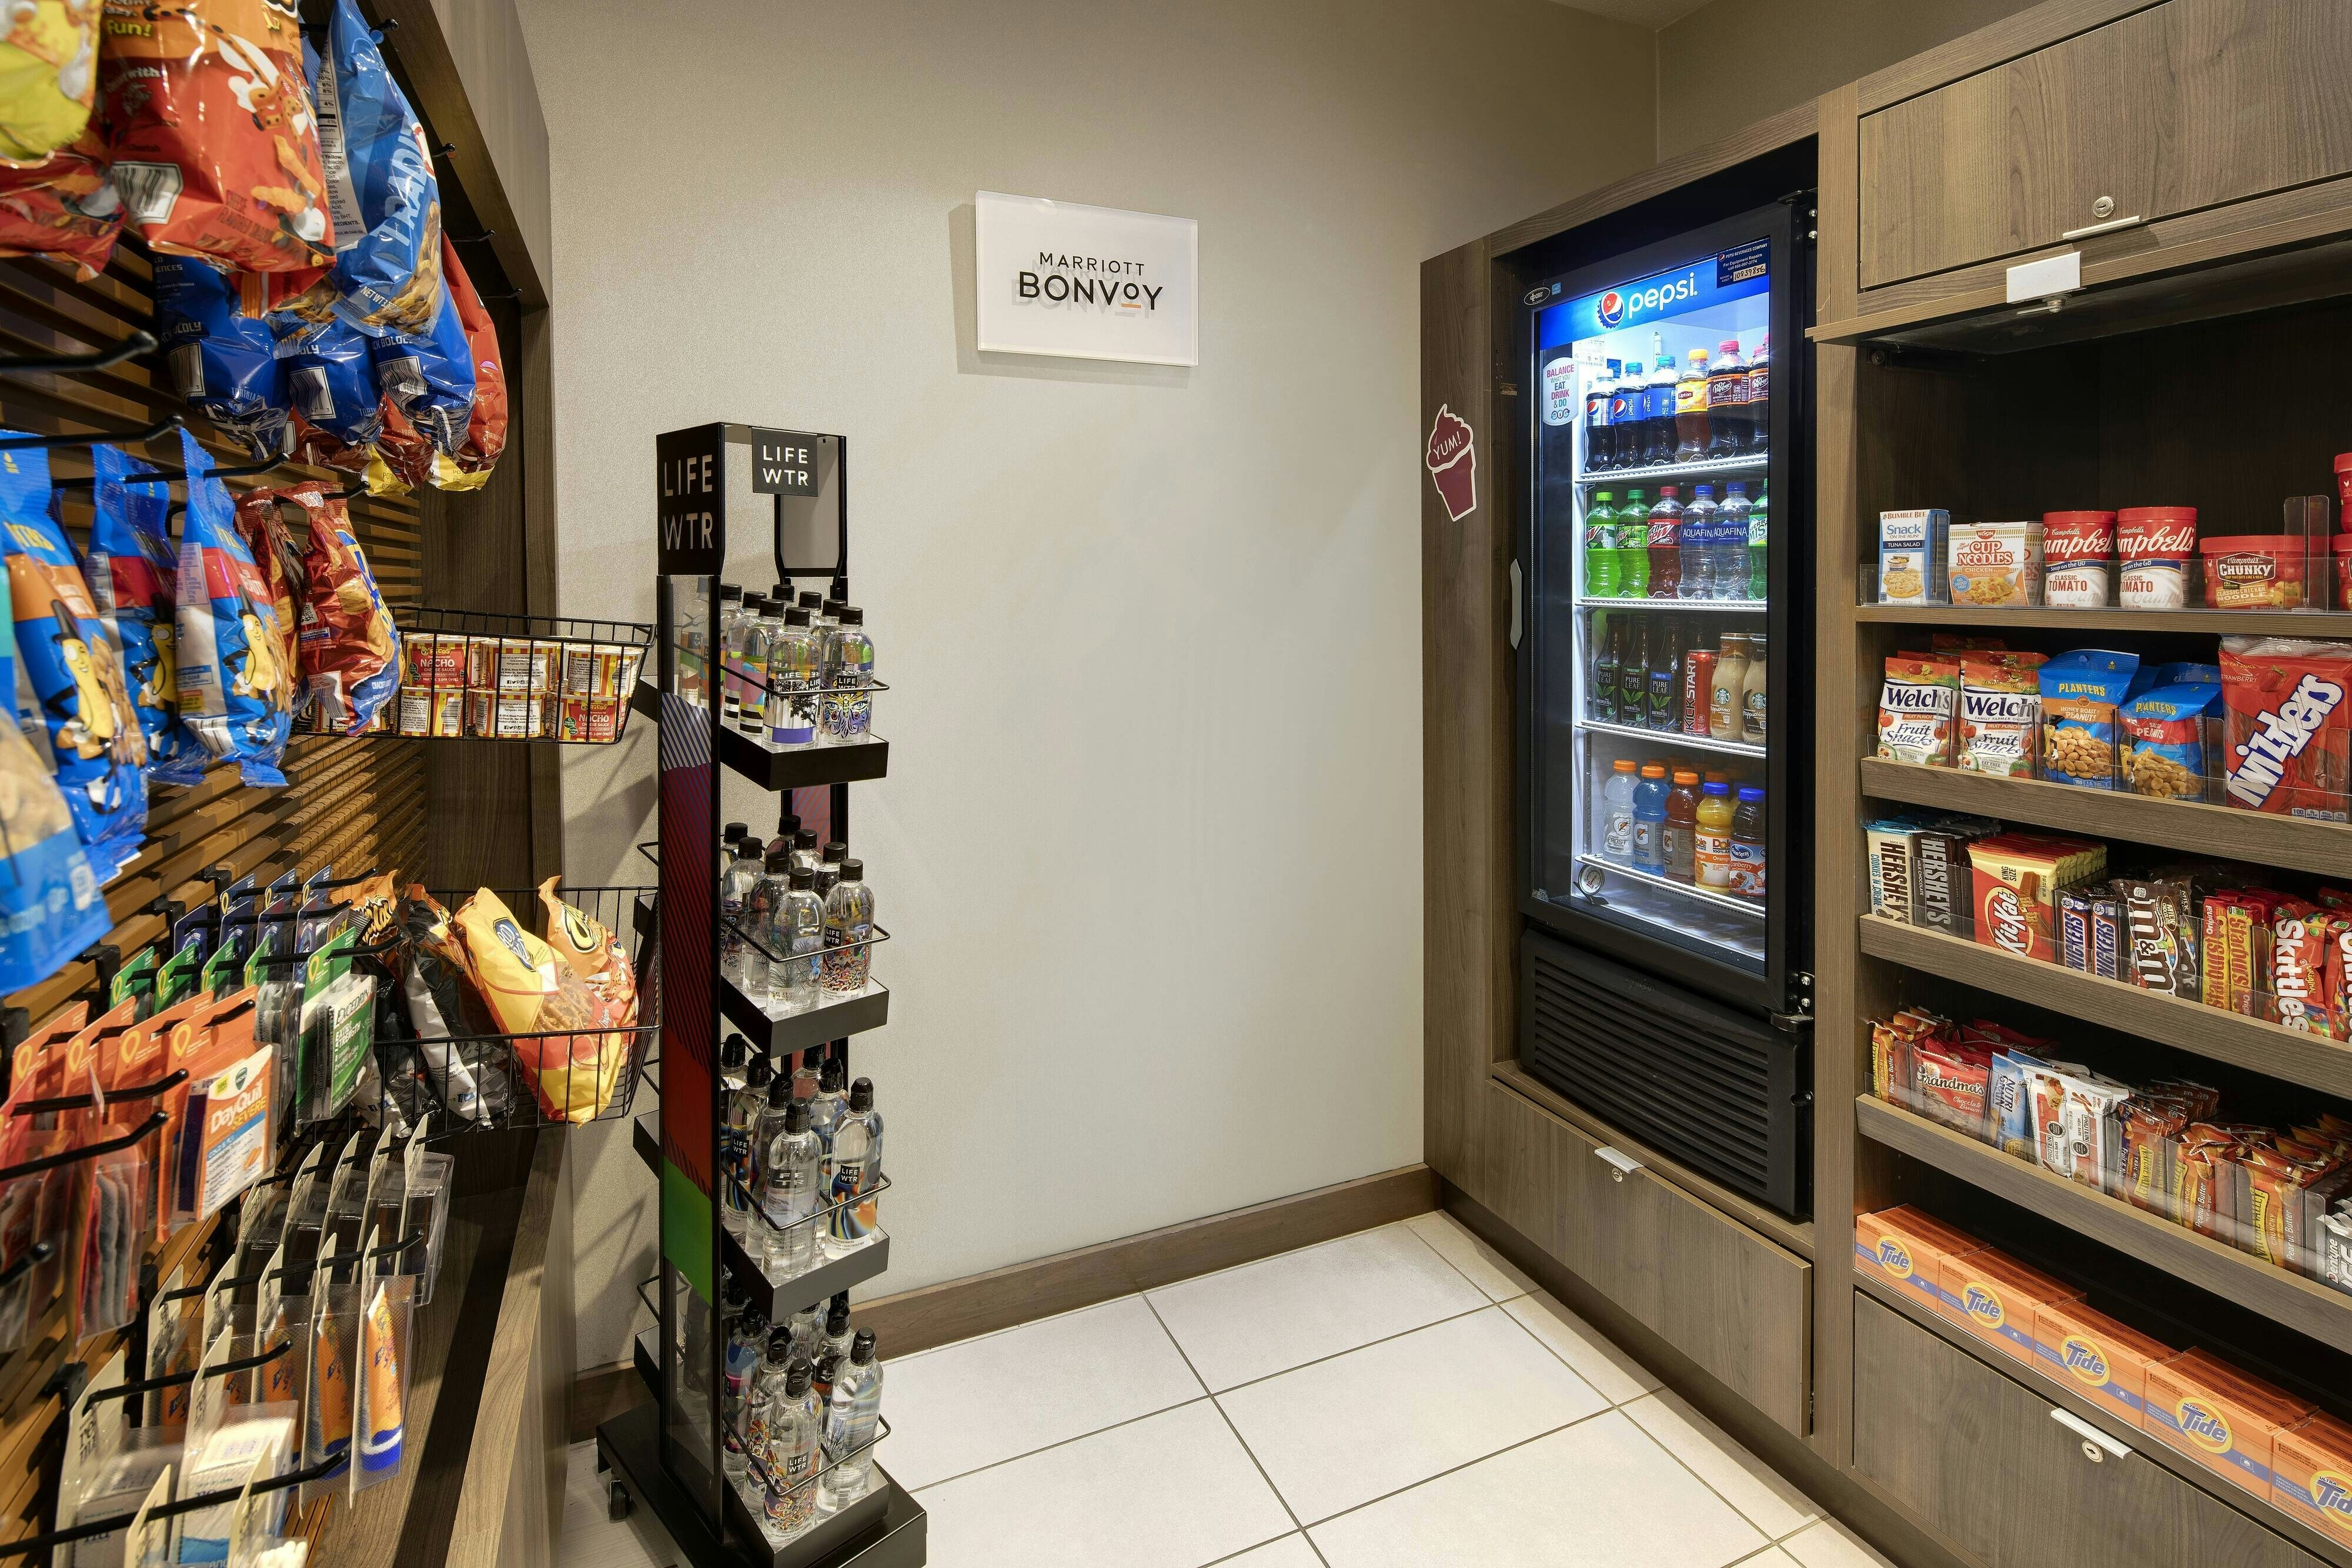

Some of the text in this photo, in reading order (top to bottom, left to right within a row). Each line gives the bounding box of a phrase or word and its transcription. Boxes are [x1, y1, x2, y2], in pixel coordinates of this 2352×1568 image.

[1735, 248, 1752, 256] BEVERAGES
[1752, 243, 1768, 251] COMPANY
[1040, 252, 1144, 276] MARRIOTT
[1019, 271, 1163, 310] BONVOY
[1628, 272, 1698, 319] pepsi
[1546, 364, 1575, 379] BALANCE
[1554, 382, 1566, 391] EAT
[1713, 382, 1732, 393] Pepper
[1551, 389, 1570, 400] DRINK
[1558, 399, 1567, 407] DO
[1433, 431, 1462, 460] YUM!
[763, 444, 808, 464] LIFE
[664, 454, 713, 497] LIFE
[762, 467, 809, 486] WTR
[662, 511, 713, 551] WTR
[1714, 527, 1749, 537] AQUAFINA
[1887, 524, 1922, 534] Snack
[1970, 541, 2002, 553] CUP
[1957, 551, 2013, 566] NOODLES
[2219, 564, 2274, 576] CHUNKY
[2049, 580, 2087, 591] TOMATO
[2217, 589, 2240, 597] CLASSIC
[2217, 592, 2268, 602] NOODLE
[2221, 674, 2257, 683] STRAWBERRY
[1684, 657, 1696, 731] KICKSTART
[2059, 683, 2106, 697] PLANTERS
[1886, 687, 1950, 710] Welch's
[1966, 696, 2039, 717] Welch's
[2065, 711, 2097, 722] PEANUTS
[1896, 723, 1931, 735] Fruit
[1885, 730, 1935, 745] Snacks
[1983, 733, 2019, 746] Fruit
[1730, 861, 1752, 870] Cranberry
[1870, 854, 1882, 907] COOKIES CREME
[2001, 866, 2009, 881] KING
[2009, 868, 2017, 882] SIZE
[1920, 839, 1952, 924] HERSHEY'S
[826, 928, 840, 937] LIFE
[2276, 918, 2310, 1032] Skittles
[1916, 1065, 1985, 1096] Grandma's
[1953, 1096, 1982, 1108] Chocolate
[2006, 1078, 2016, 1113] NUTRI
[211, 1078, 263, 1134] DayQuil
[233, 1096, 266, 1129] SEVERE
[733, 1138, 747, 1148] LIFE
[733, 1146, 747, 1155] WTR
[2184, 1182, 2192, 1213] CRUNCHY
[2195, 1182, 2206, 1228] Peanut Butter
[2269, 1213, 2277, 1246] CRUNCHY
[2285, 1209, 2295, 1261] Peanut Butter
[1880, 1243, 1910, 1269] Tide
[2326, 1238, 2341, 1285] Dentyne
[1966, 1289, 2001, 1319] Tide
[2066, 1343, 2106, 1376] Tide
[2183, 1402, 2199, 1411] ULTRA
[2181, 1405, 2228, 1442] Tide
[789, 1455, 807, 1466] LIFE
[789, 1462, 807, 1473] WTR
[2319, 1476, 2337, 1486] ULTRA
[2315, 1479, 2352, 1515] Tid
